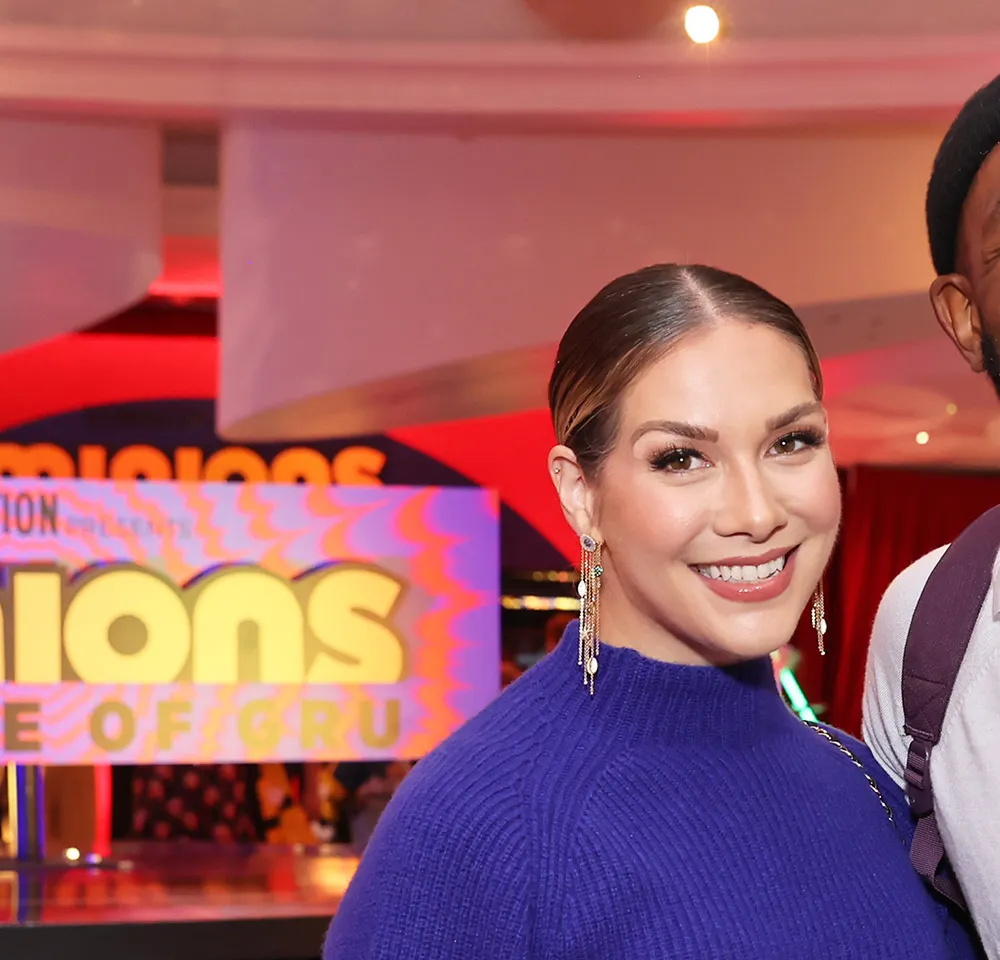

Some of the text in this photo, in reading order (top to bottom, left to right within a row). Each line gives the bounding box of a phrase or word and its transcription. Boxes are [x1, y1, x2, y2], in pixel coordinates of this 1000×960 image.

[2, 493, 57, 535] ION
[4, 700, 401, 752] E OF GRU
